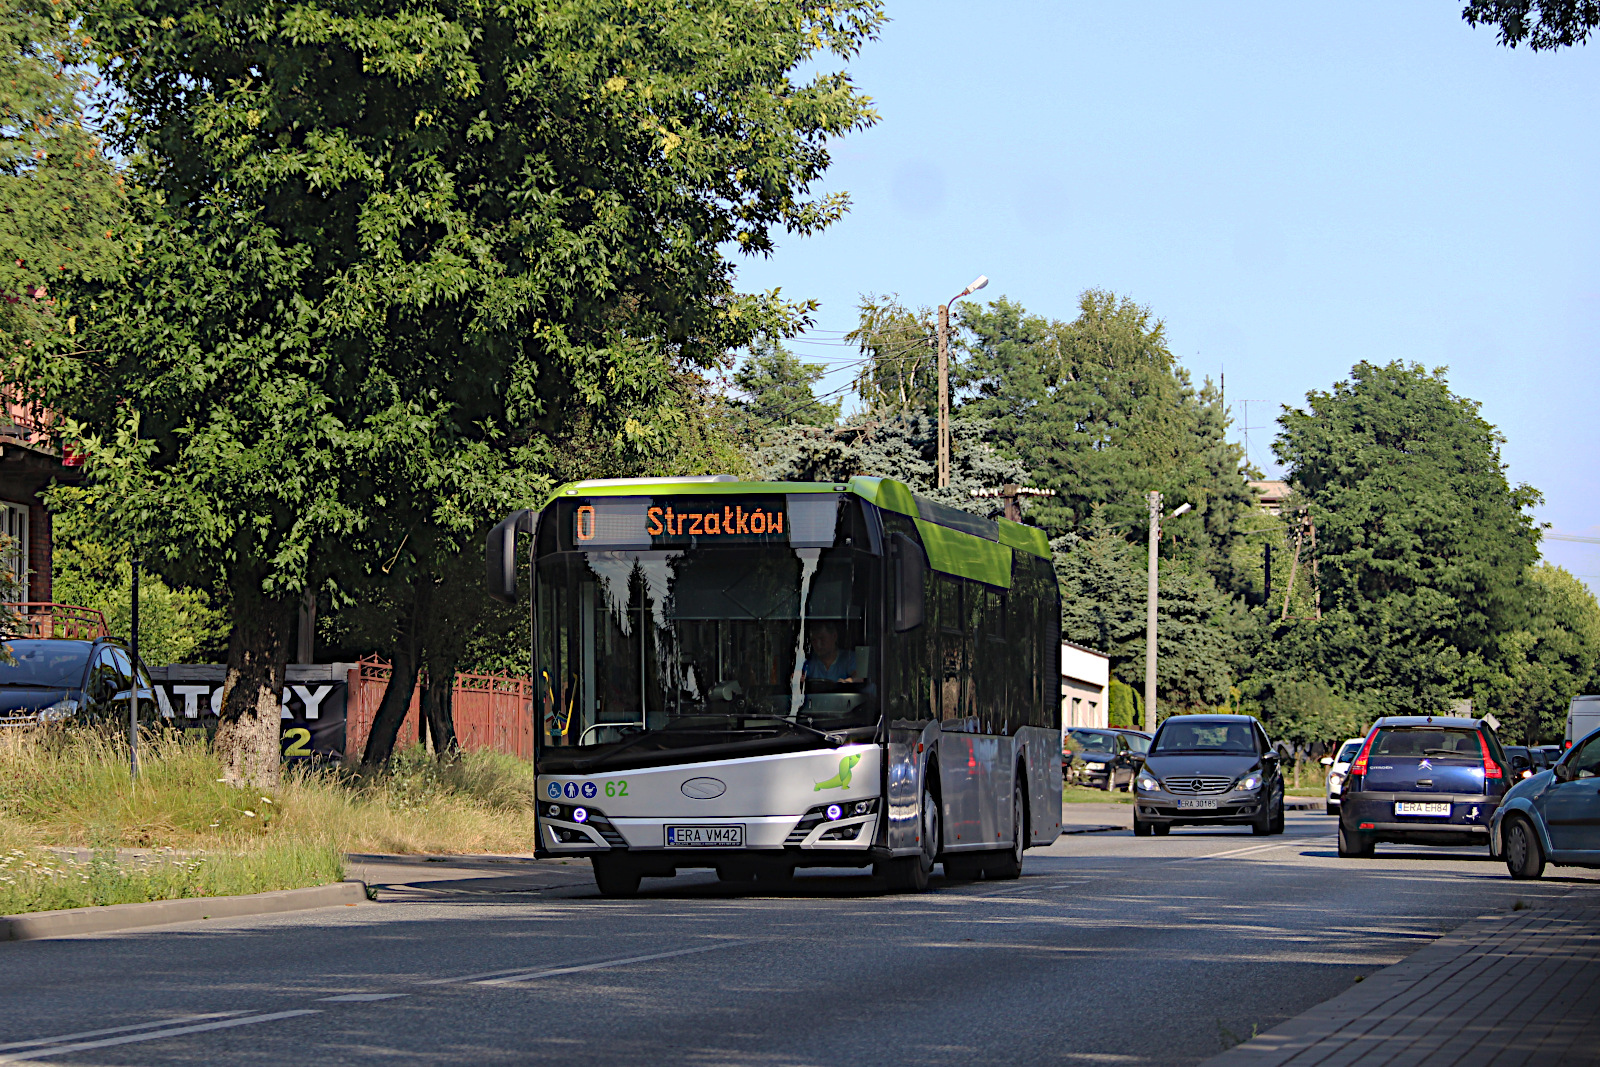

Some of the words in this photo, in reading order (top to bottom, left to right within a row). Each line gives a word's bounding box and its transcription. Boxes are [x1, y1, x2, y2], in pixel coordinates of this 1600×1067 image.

[647, 505, 783, 536] Strzałków
[605, 780, 629, 798] 62
[1181, 800, 1194, 808] ERA
[1403, 802, 1422, 812] ERA
[677, 829, 701, 842] ERA
[706, 829, 738, 842] VM42
